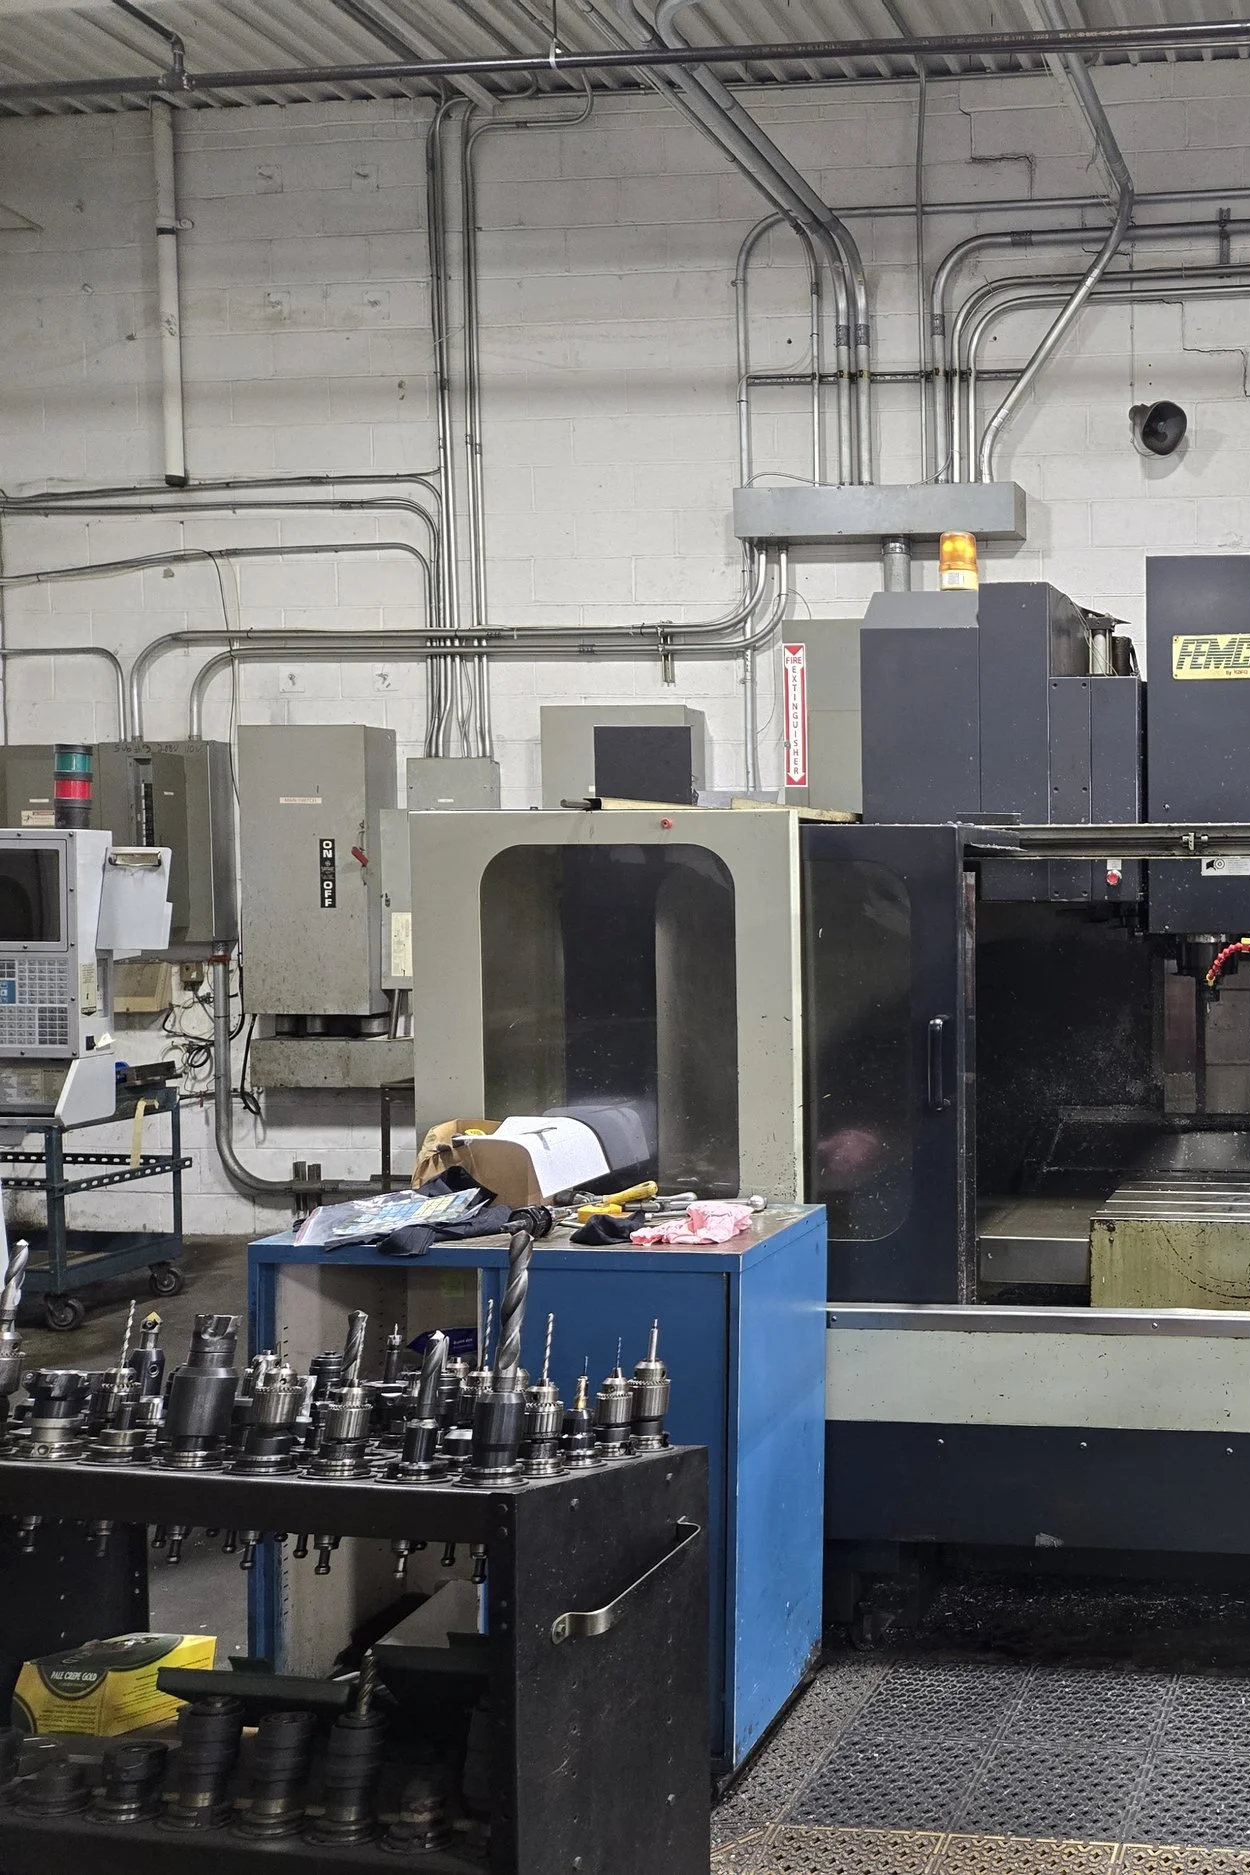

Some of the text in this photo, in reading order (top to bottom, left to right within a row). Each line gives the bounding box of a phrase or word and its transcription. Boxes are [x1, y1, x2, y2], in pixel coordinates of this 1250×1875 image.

[785, 656, 802, 665] FIRE
[791, 666, 799, 775] EXTINGUISHER
[322, 840, 333, 858] ON
[323, 881, 333, 907] OFF
[82, 1672, 98, 1681] GOLD
